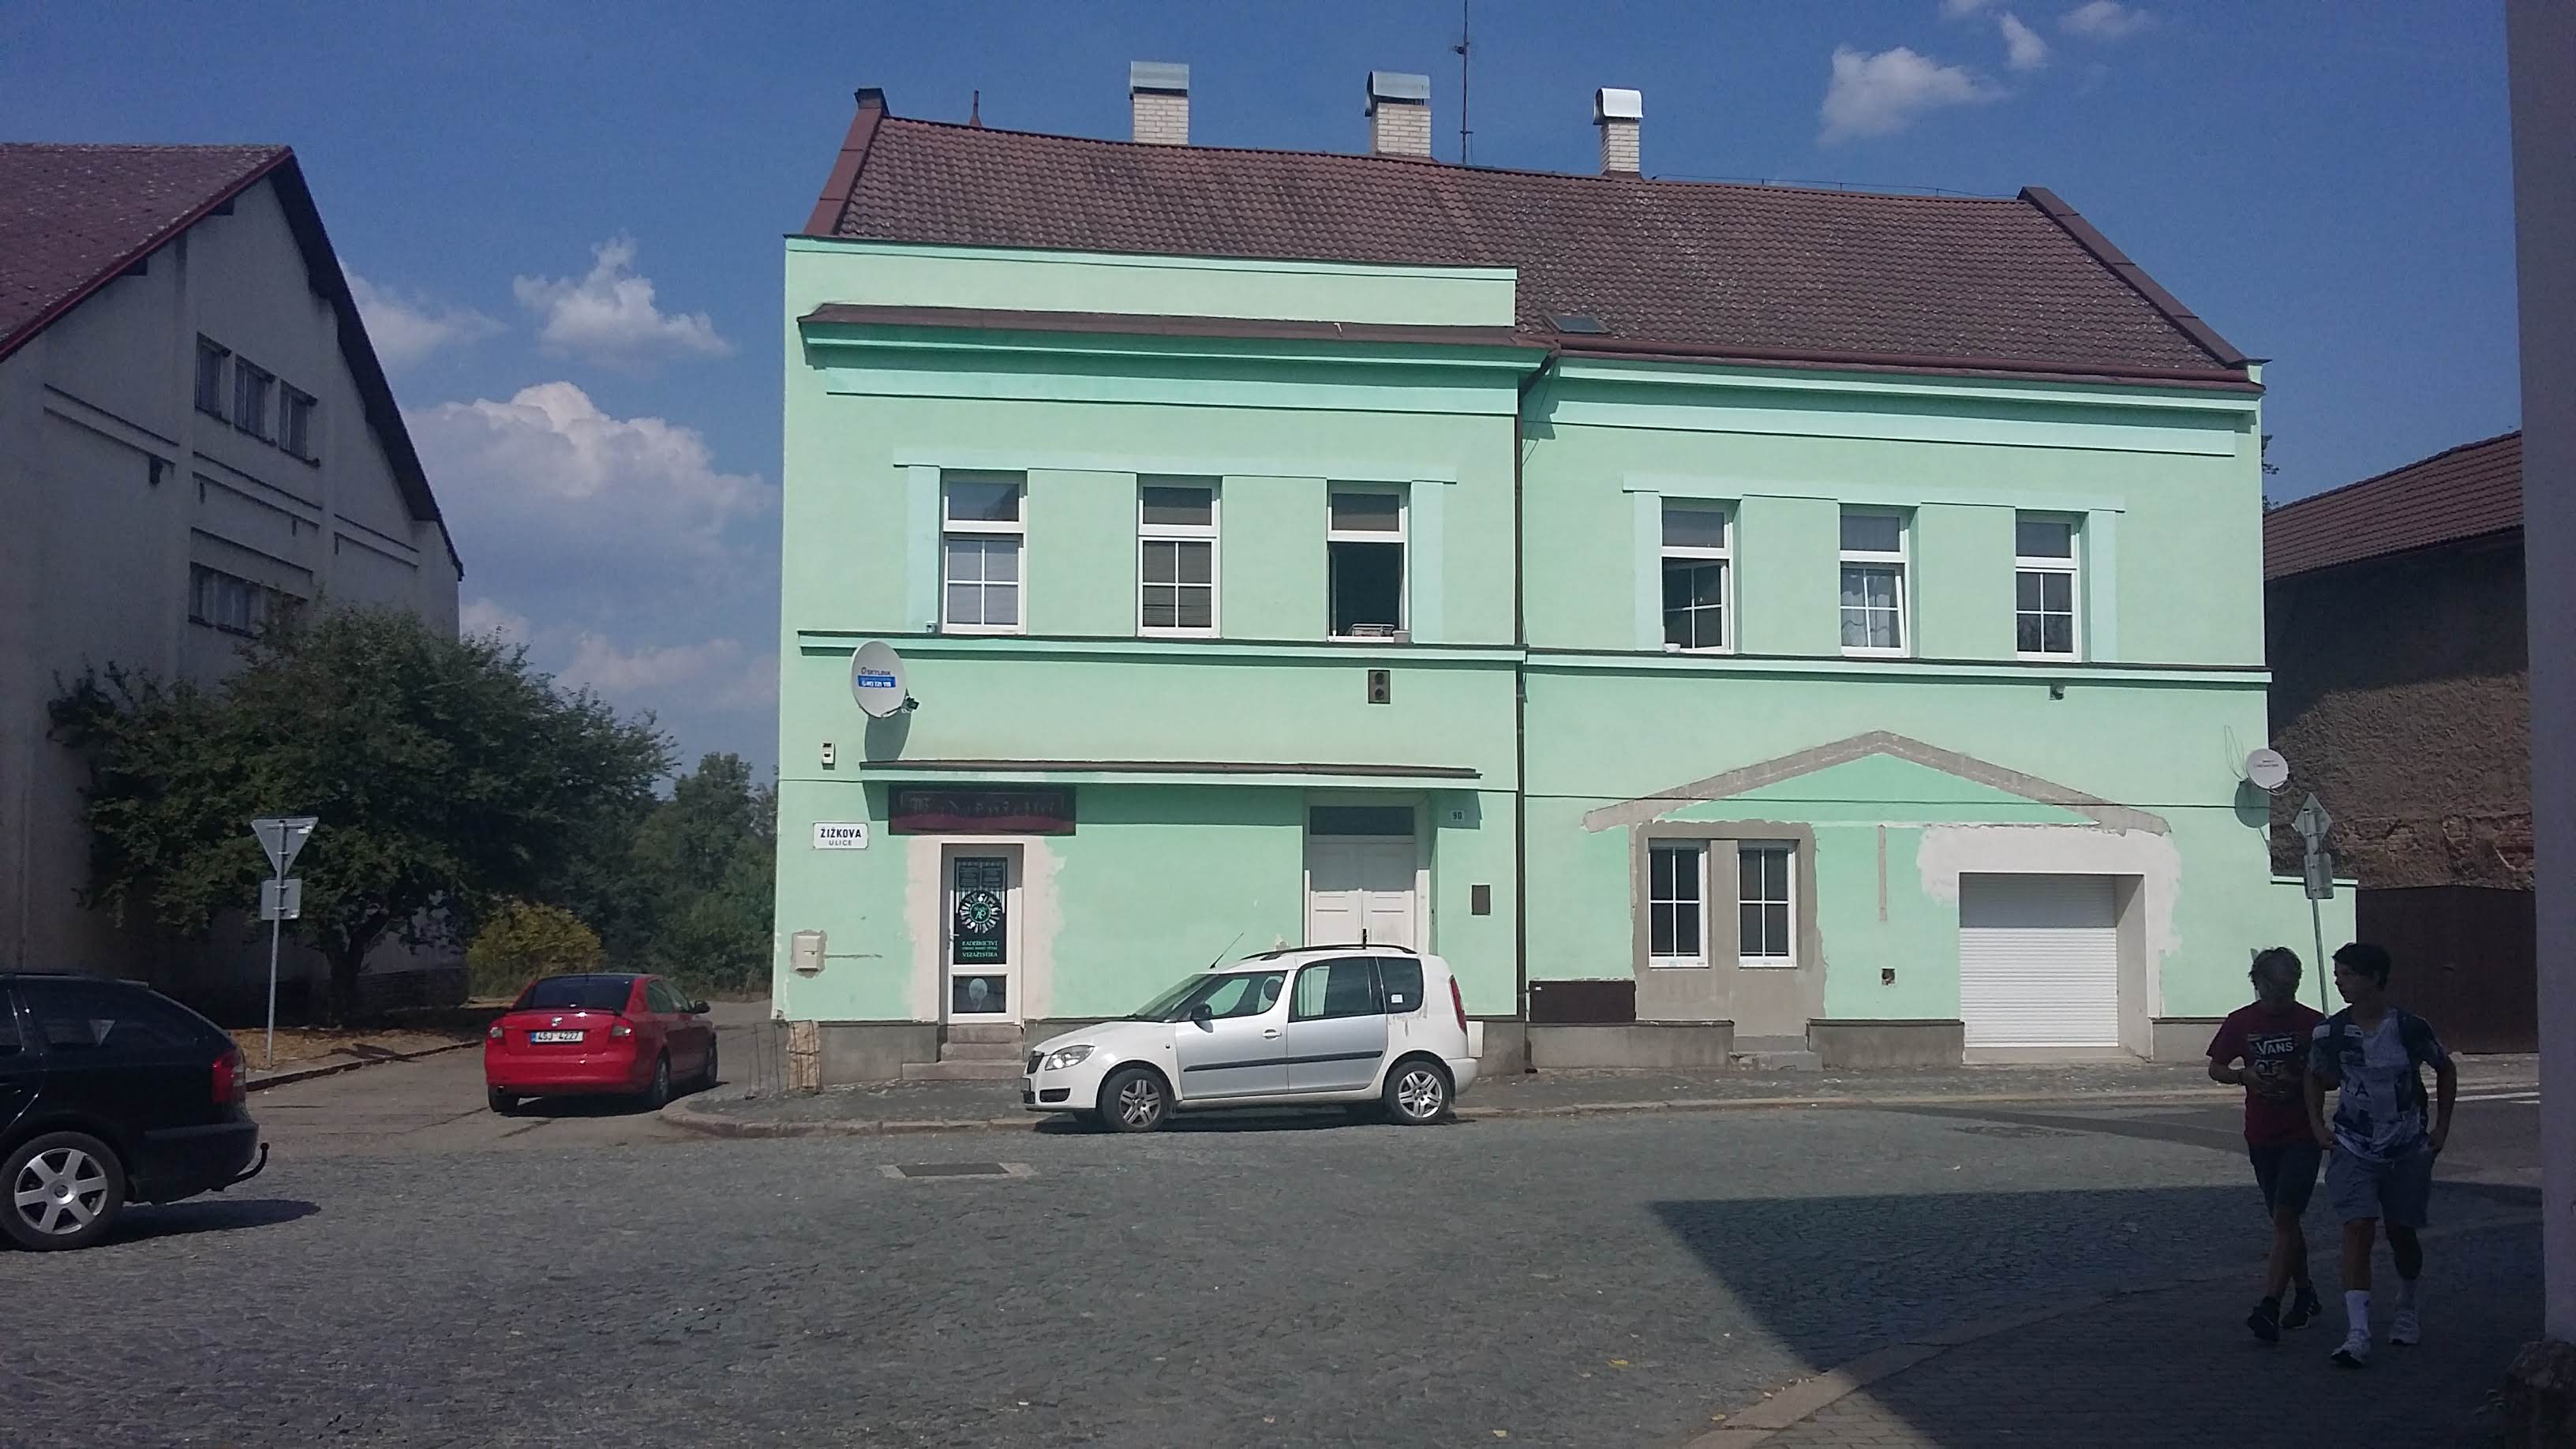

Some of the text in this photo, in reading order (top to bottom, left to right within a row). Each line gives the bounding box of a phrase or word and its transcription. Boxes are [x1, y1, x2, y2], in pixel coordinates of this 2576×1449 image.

[538, 1032, 579, 1040] 4SJ 4227
[2256, 1037, 2294, 1055] VANS
